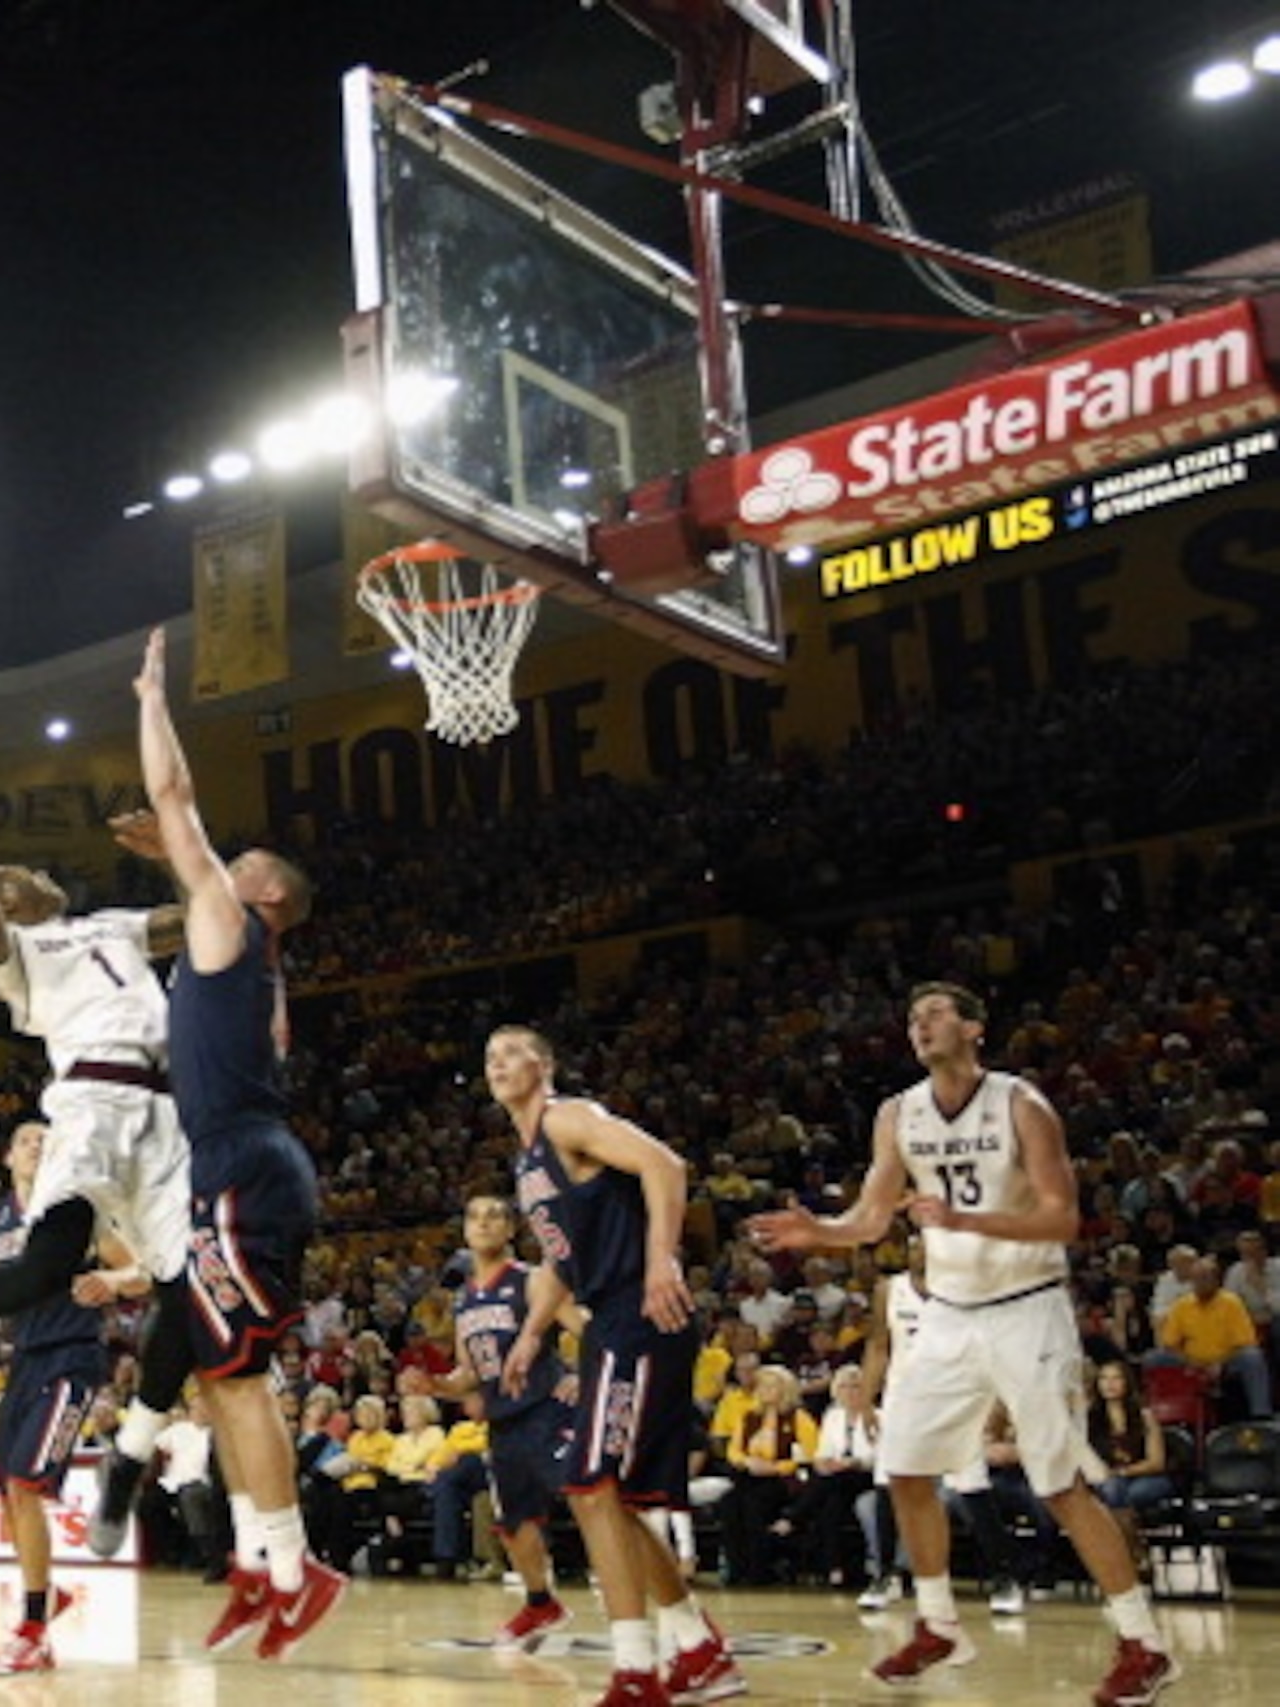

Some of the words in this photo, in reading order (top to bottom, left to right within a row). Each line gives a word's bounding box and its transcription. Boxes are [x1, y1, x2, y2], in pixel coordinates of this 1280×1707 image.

[821, 515, 981, 597] FOLLOW
[988, 497, 1054, 550] US
[263, 679, 615, 838] HOME
[830, 548, 1128, 733] THE
[90, 945, 125, 990] 1
[935, 1163, 982, 1208] 13
